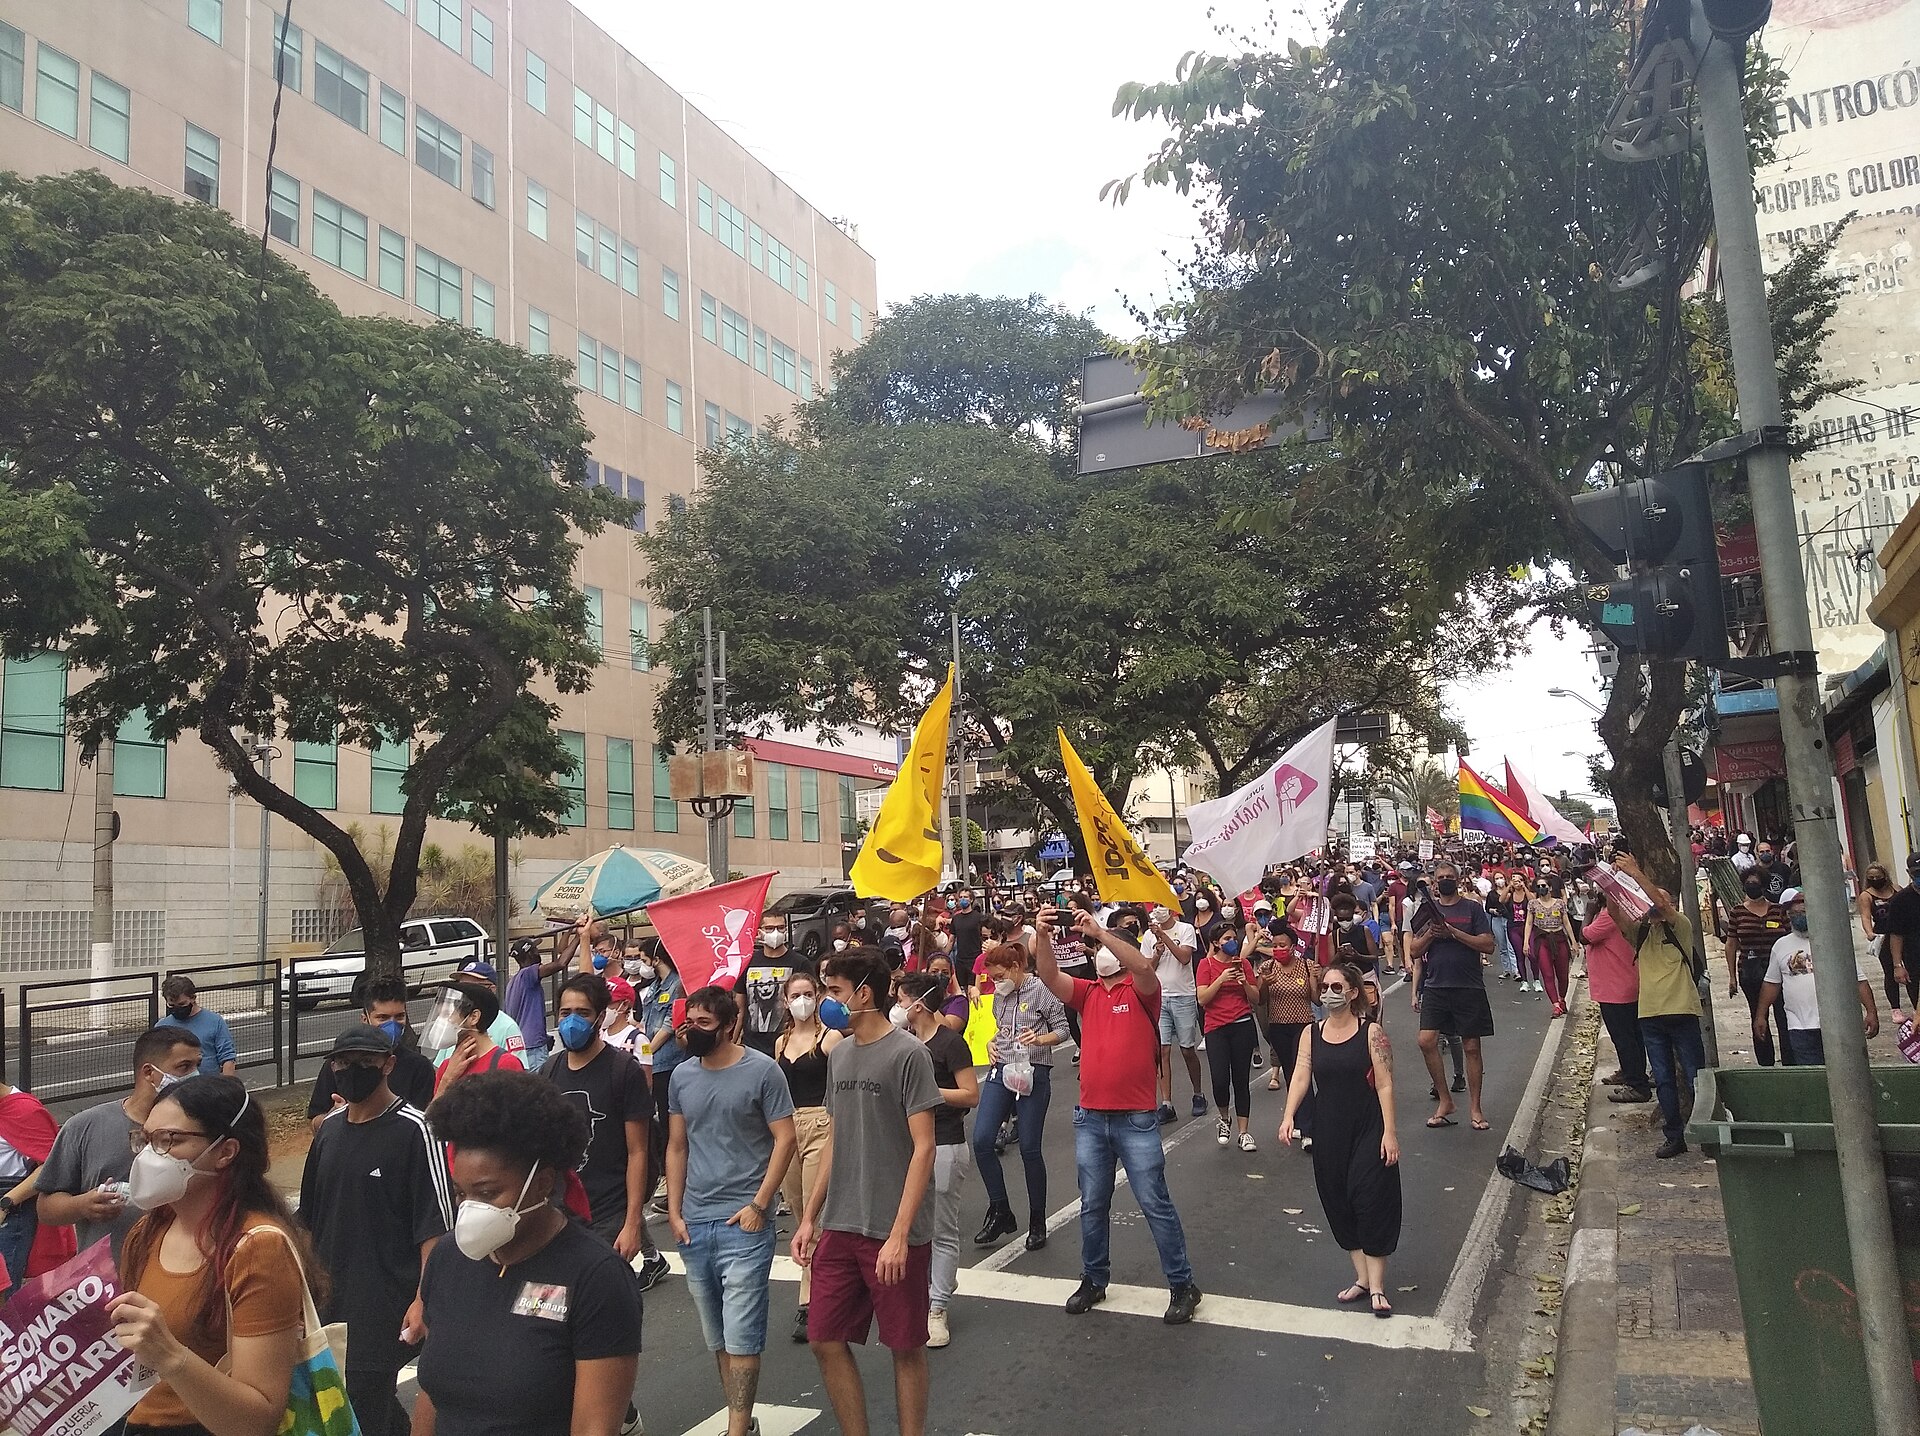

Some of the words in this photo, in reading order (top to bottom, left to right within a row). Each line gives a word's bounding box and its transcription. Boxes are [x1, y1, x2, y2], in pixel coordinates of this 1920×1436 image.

[1773, 59, 1920, 137] ENTROCÓ
[1847, 154, 1920, 198] COLOR
[1886, 405, 1915, 440] DE
[663, 863, 689, 877] PORTO
[553, 892, 581, 900] SEGURO
[835, 1080, 857, 1094] your
